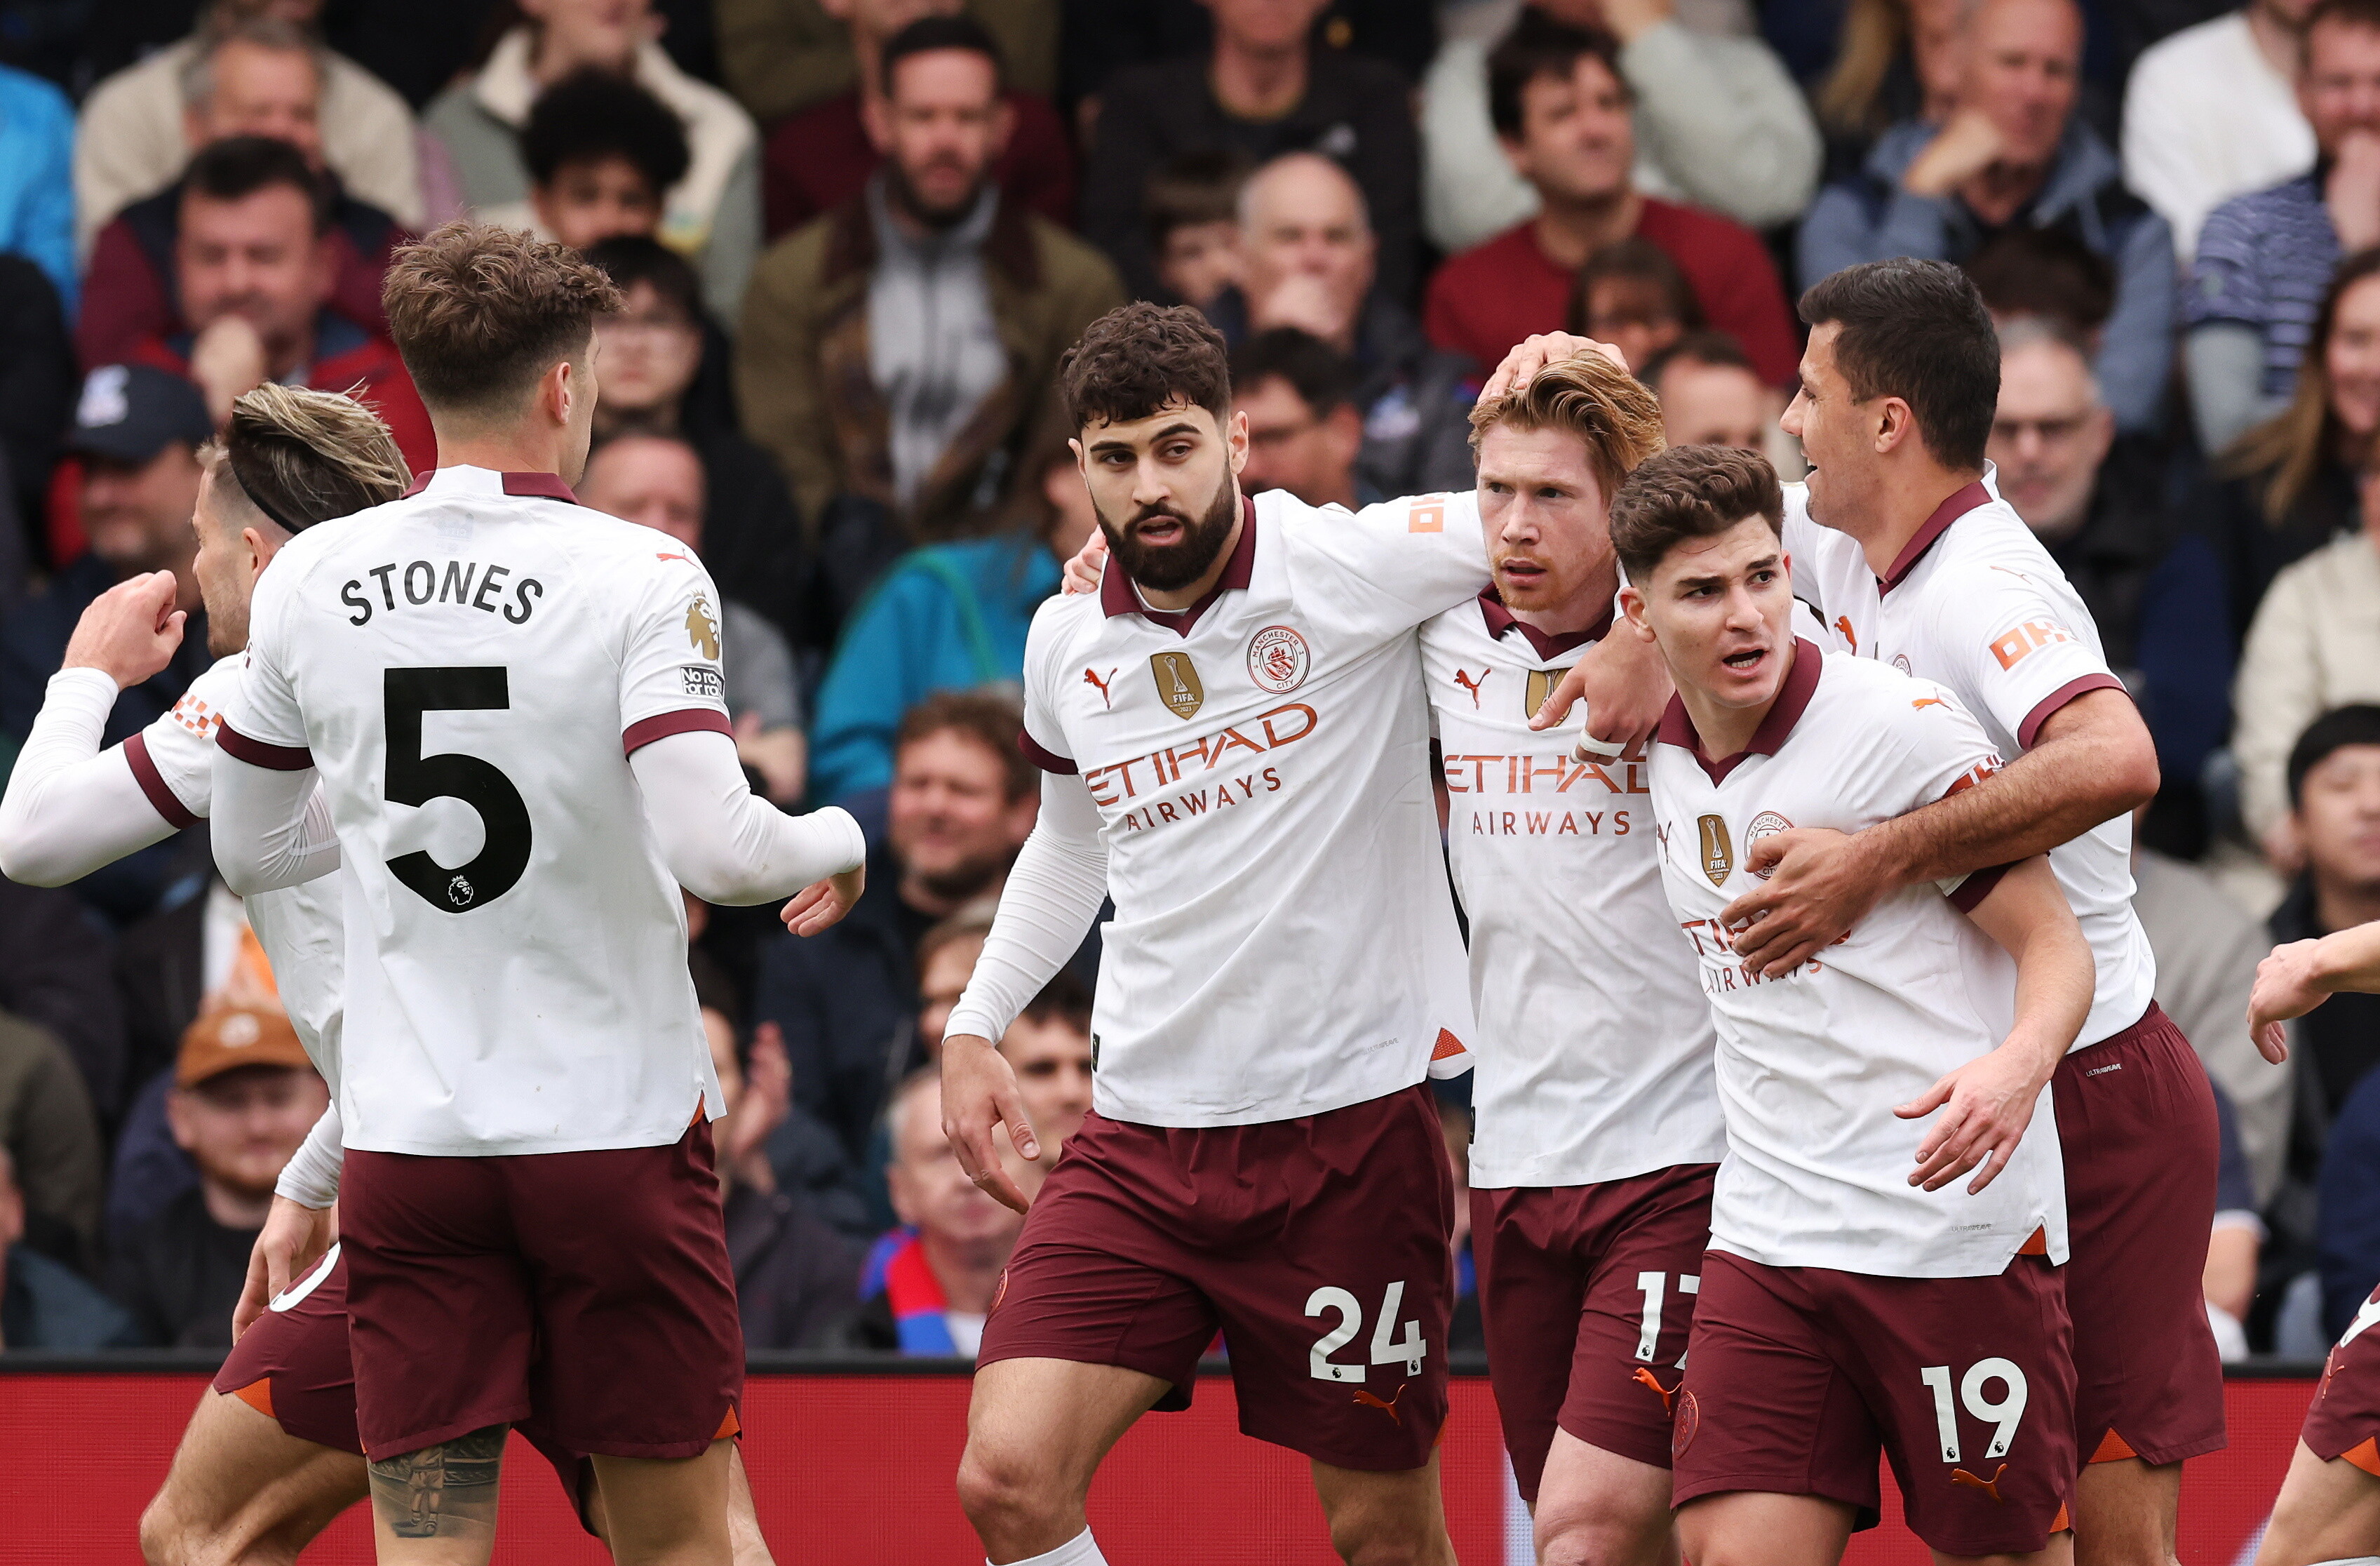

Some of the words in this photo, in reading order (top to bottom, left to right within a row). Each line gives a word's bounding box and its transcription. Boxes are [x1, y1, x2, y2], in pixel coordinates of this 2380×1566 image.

[339, 560, 544, 627] STONES
[1252, 631, 1299, 657] MANCHESTER
[680, 667, 702, 683] No
[1276, 678, 1293, 689] CITY
[1172, 692, 1195, 704] FIFA
[1084, 703, 1319, 807] ETIHAD
[384, 666, 533, 914] 5
[1125, 767, 1282, 831] AIRWAYS
[1472, 810, 1631, 836] AIRWAYS
[1749, 816, 1788, 838] MANCHESTE
[1710, 859, 1726, 869] FIFA
[1705, 957, 1823, 993] AIRWS
[2085, 1063, 2123, 1077] ULTRAWEAVE
[1304, 1280, 1427, 1383] 24
[1921, 1356, 2029, 1464] 19
